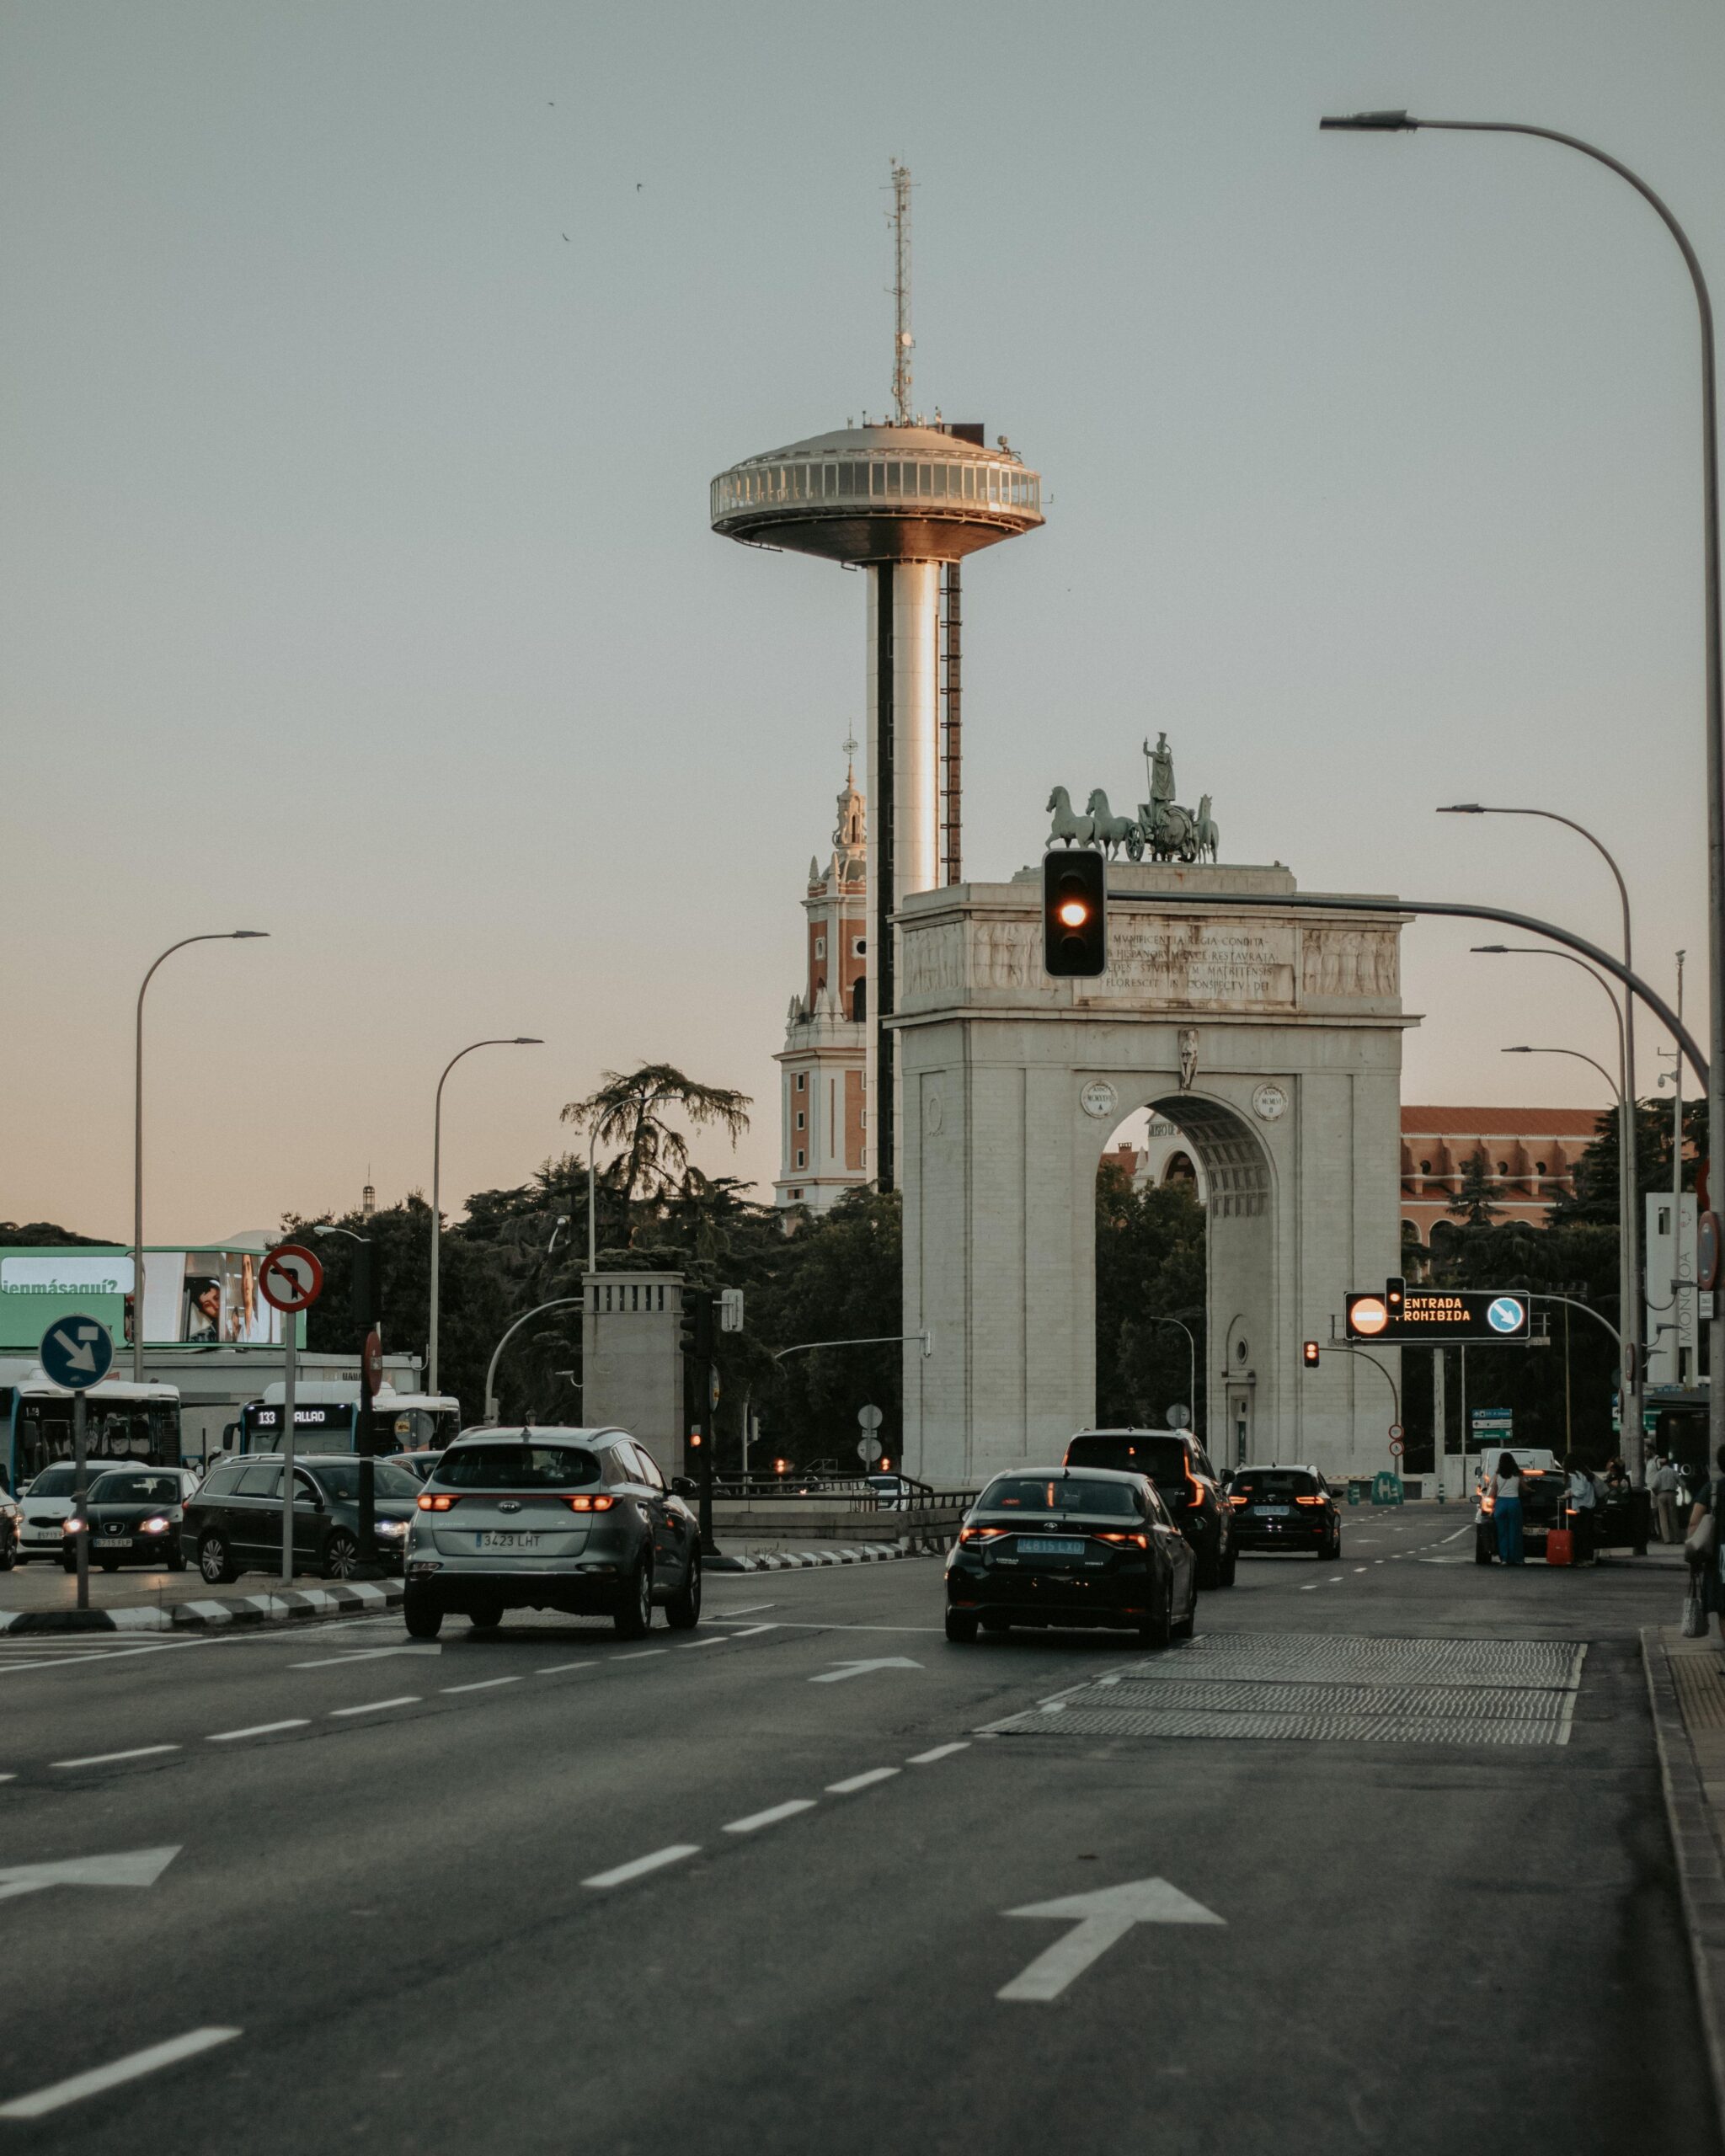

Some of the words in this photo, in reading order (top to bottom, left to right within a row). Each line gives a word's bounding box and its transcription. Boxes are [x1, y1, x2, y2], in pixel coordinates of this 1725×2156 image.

[1106, 979, 1159, 988] FLORESCIT
[1253, 981, 1268, 991] DEI
[1679, 1251, 1692, 1342] MONCOA
[1404, 1298, 1463, 1309] ENTRADA
[1396, 1310, 1471, 1321] ROHIBIDA
[259, 1412, 276, 1424] 133
[294, 1411, 325, 1422] ALLAO
[484, 1535, 514, 1547] 3423
[518, 1535, 541, 1547] LHT
